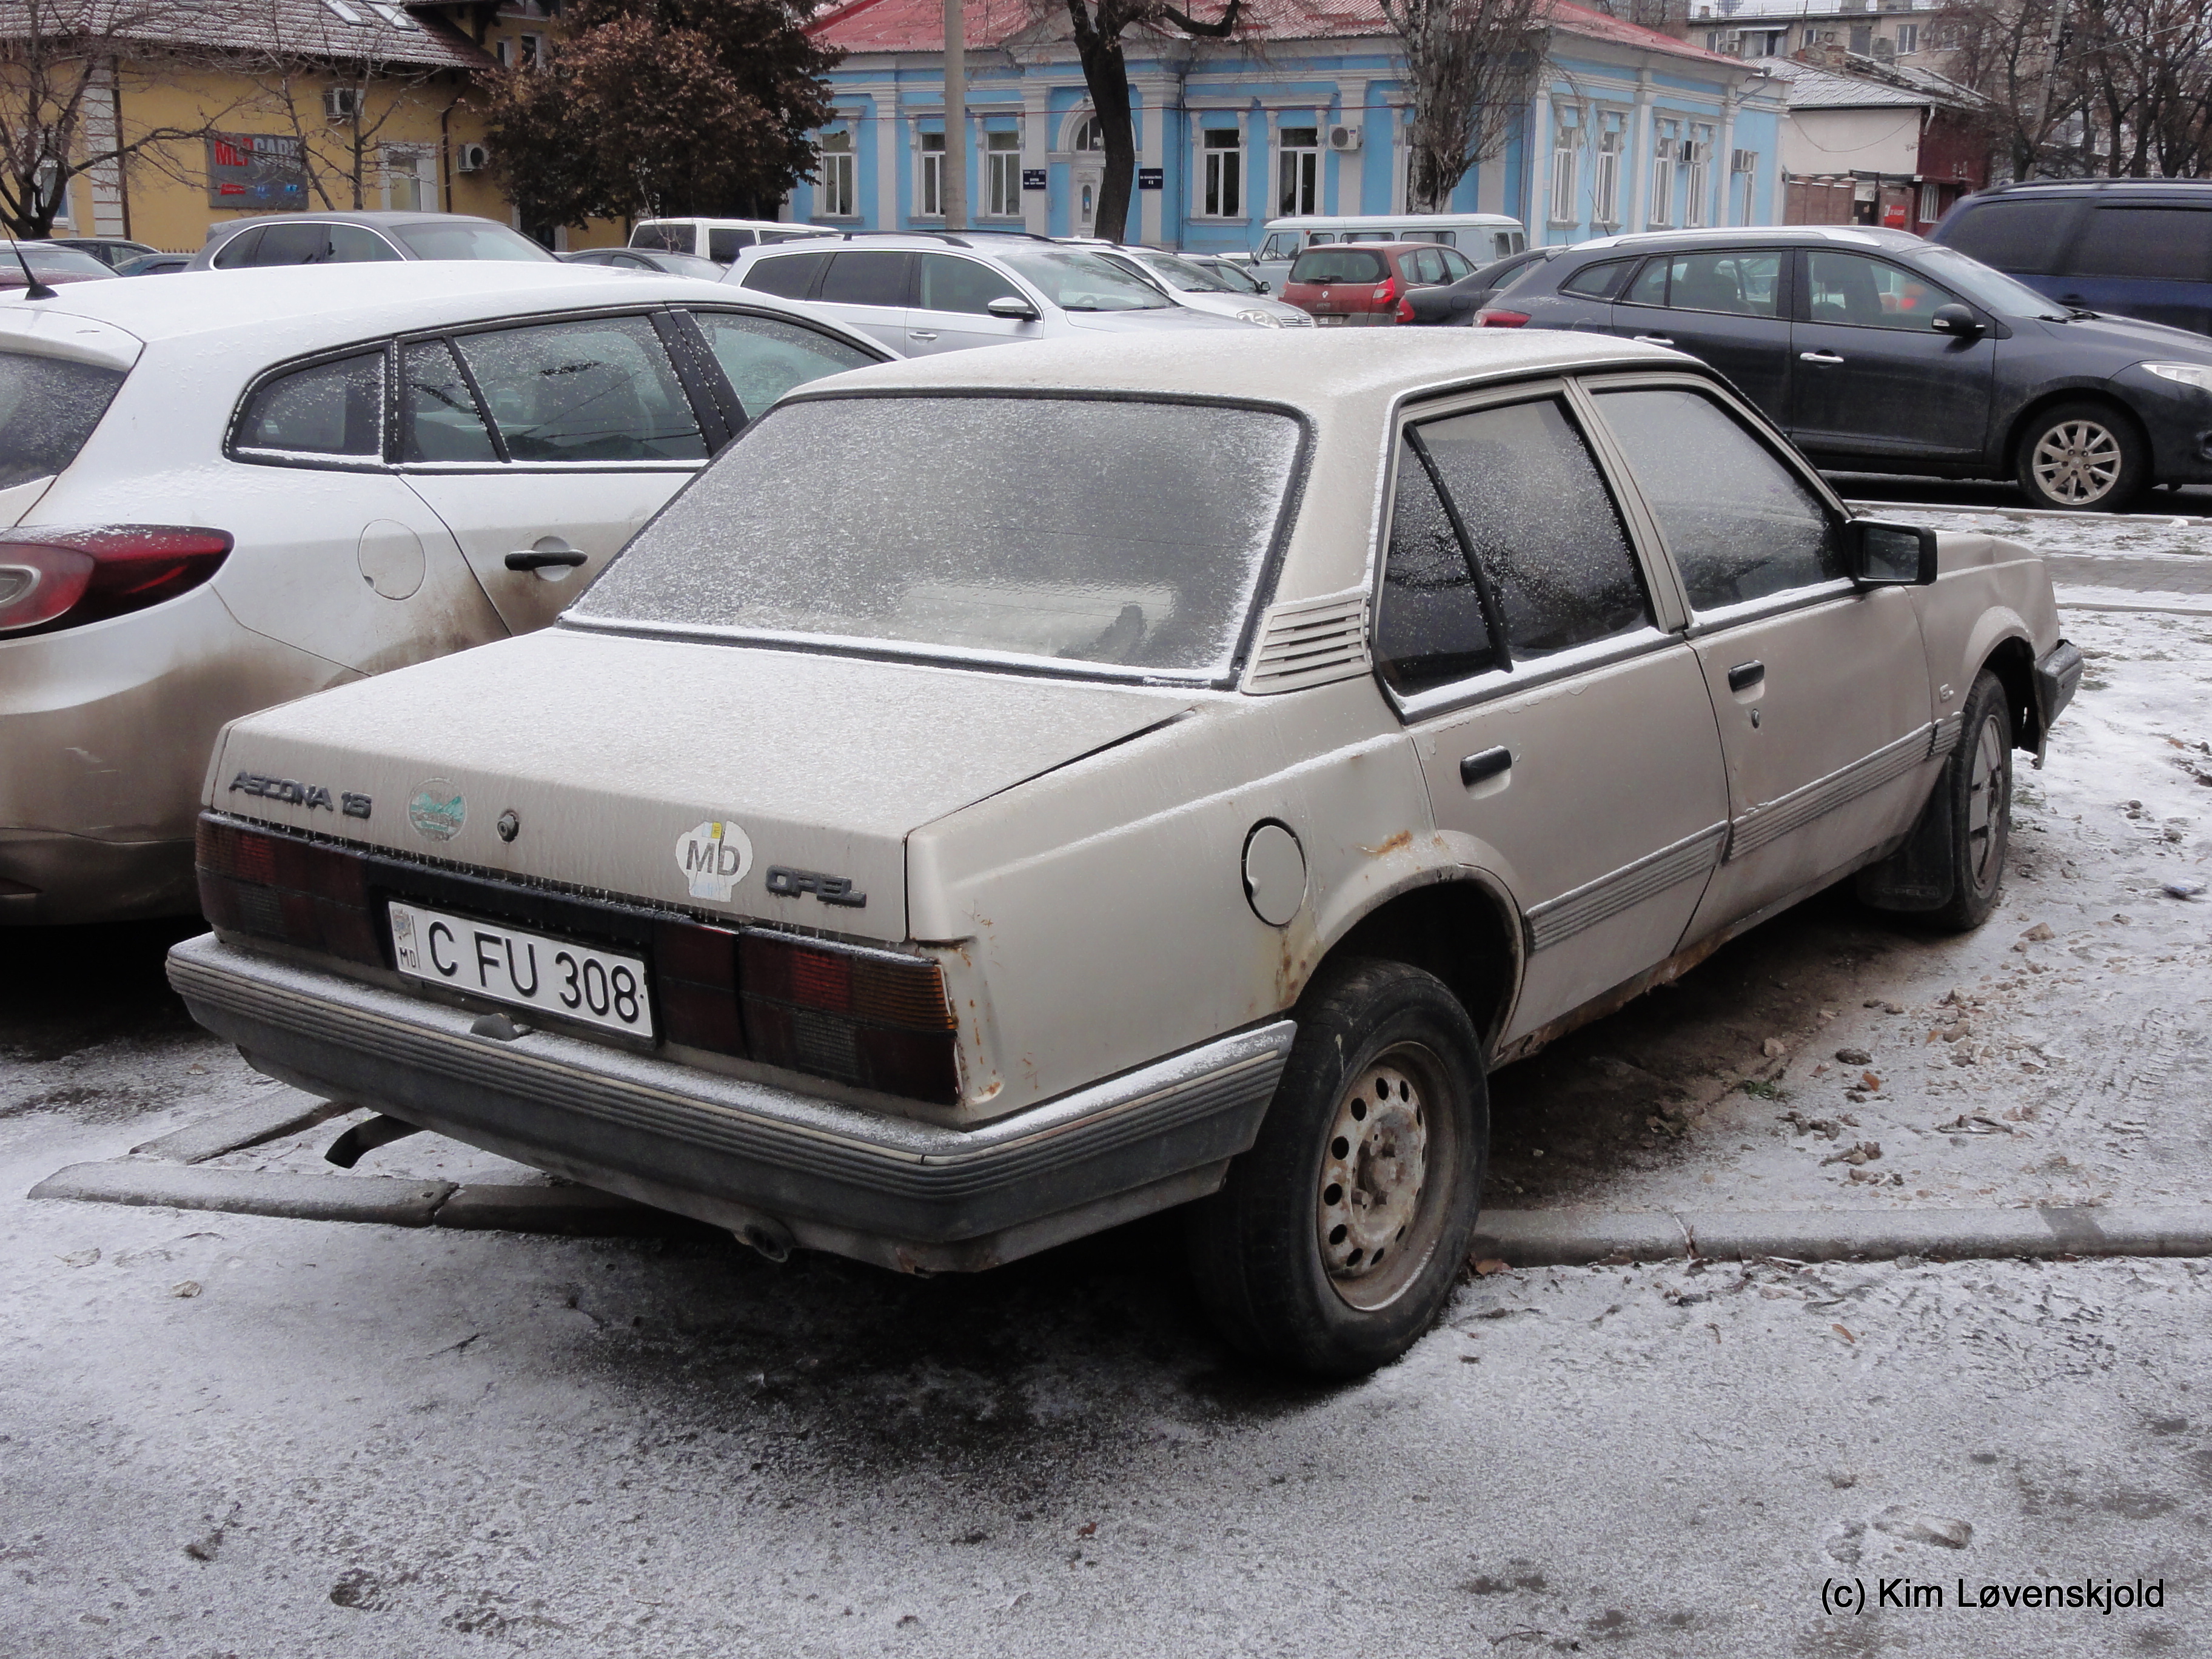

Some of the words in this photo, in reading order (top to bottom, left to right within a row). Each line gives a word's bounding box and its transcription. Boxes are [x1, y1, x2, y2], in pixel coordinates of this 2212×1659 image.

[229, 771, 333, 812] ASCONA
[686, 839, 741, 876] MD
[765, 865, 867, 908] OPEL
[398, 946, 417, 968] MD
[429, 921, 458, 977] C
[474, 930, 539, 998] FU
[554, 950, 640, 1024] 308
